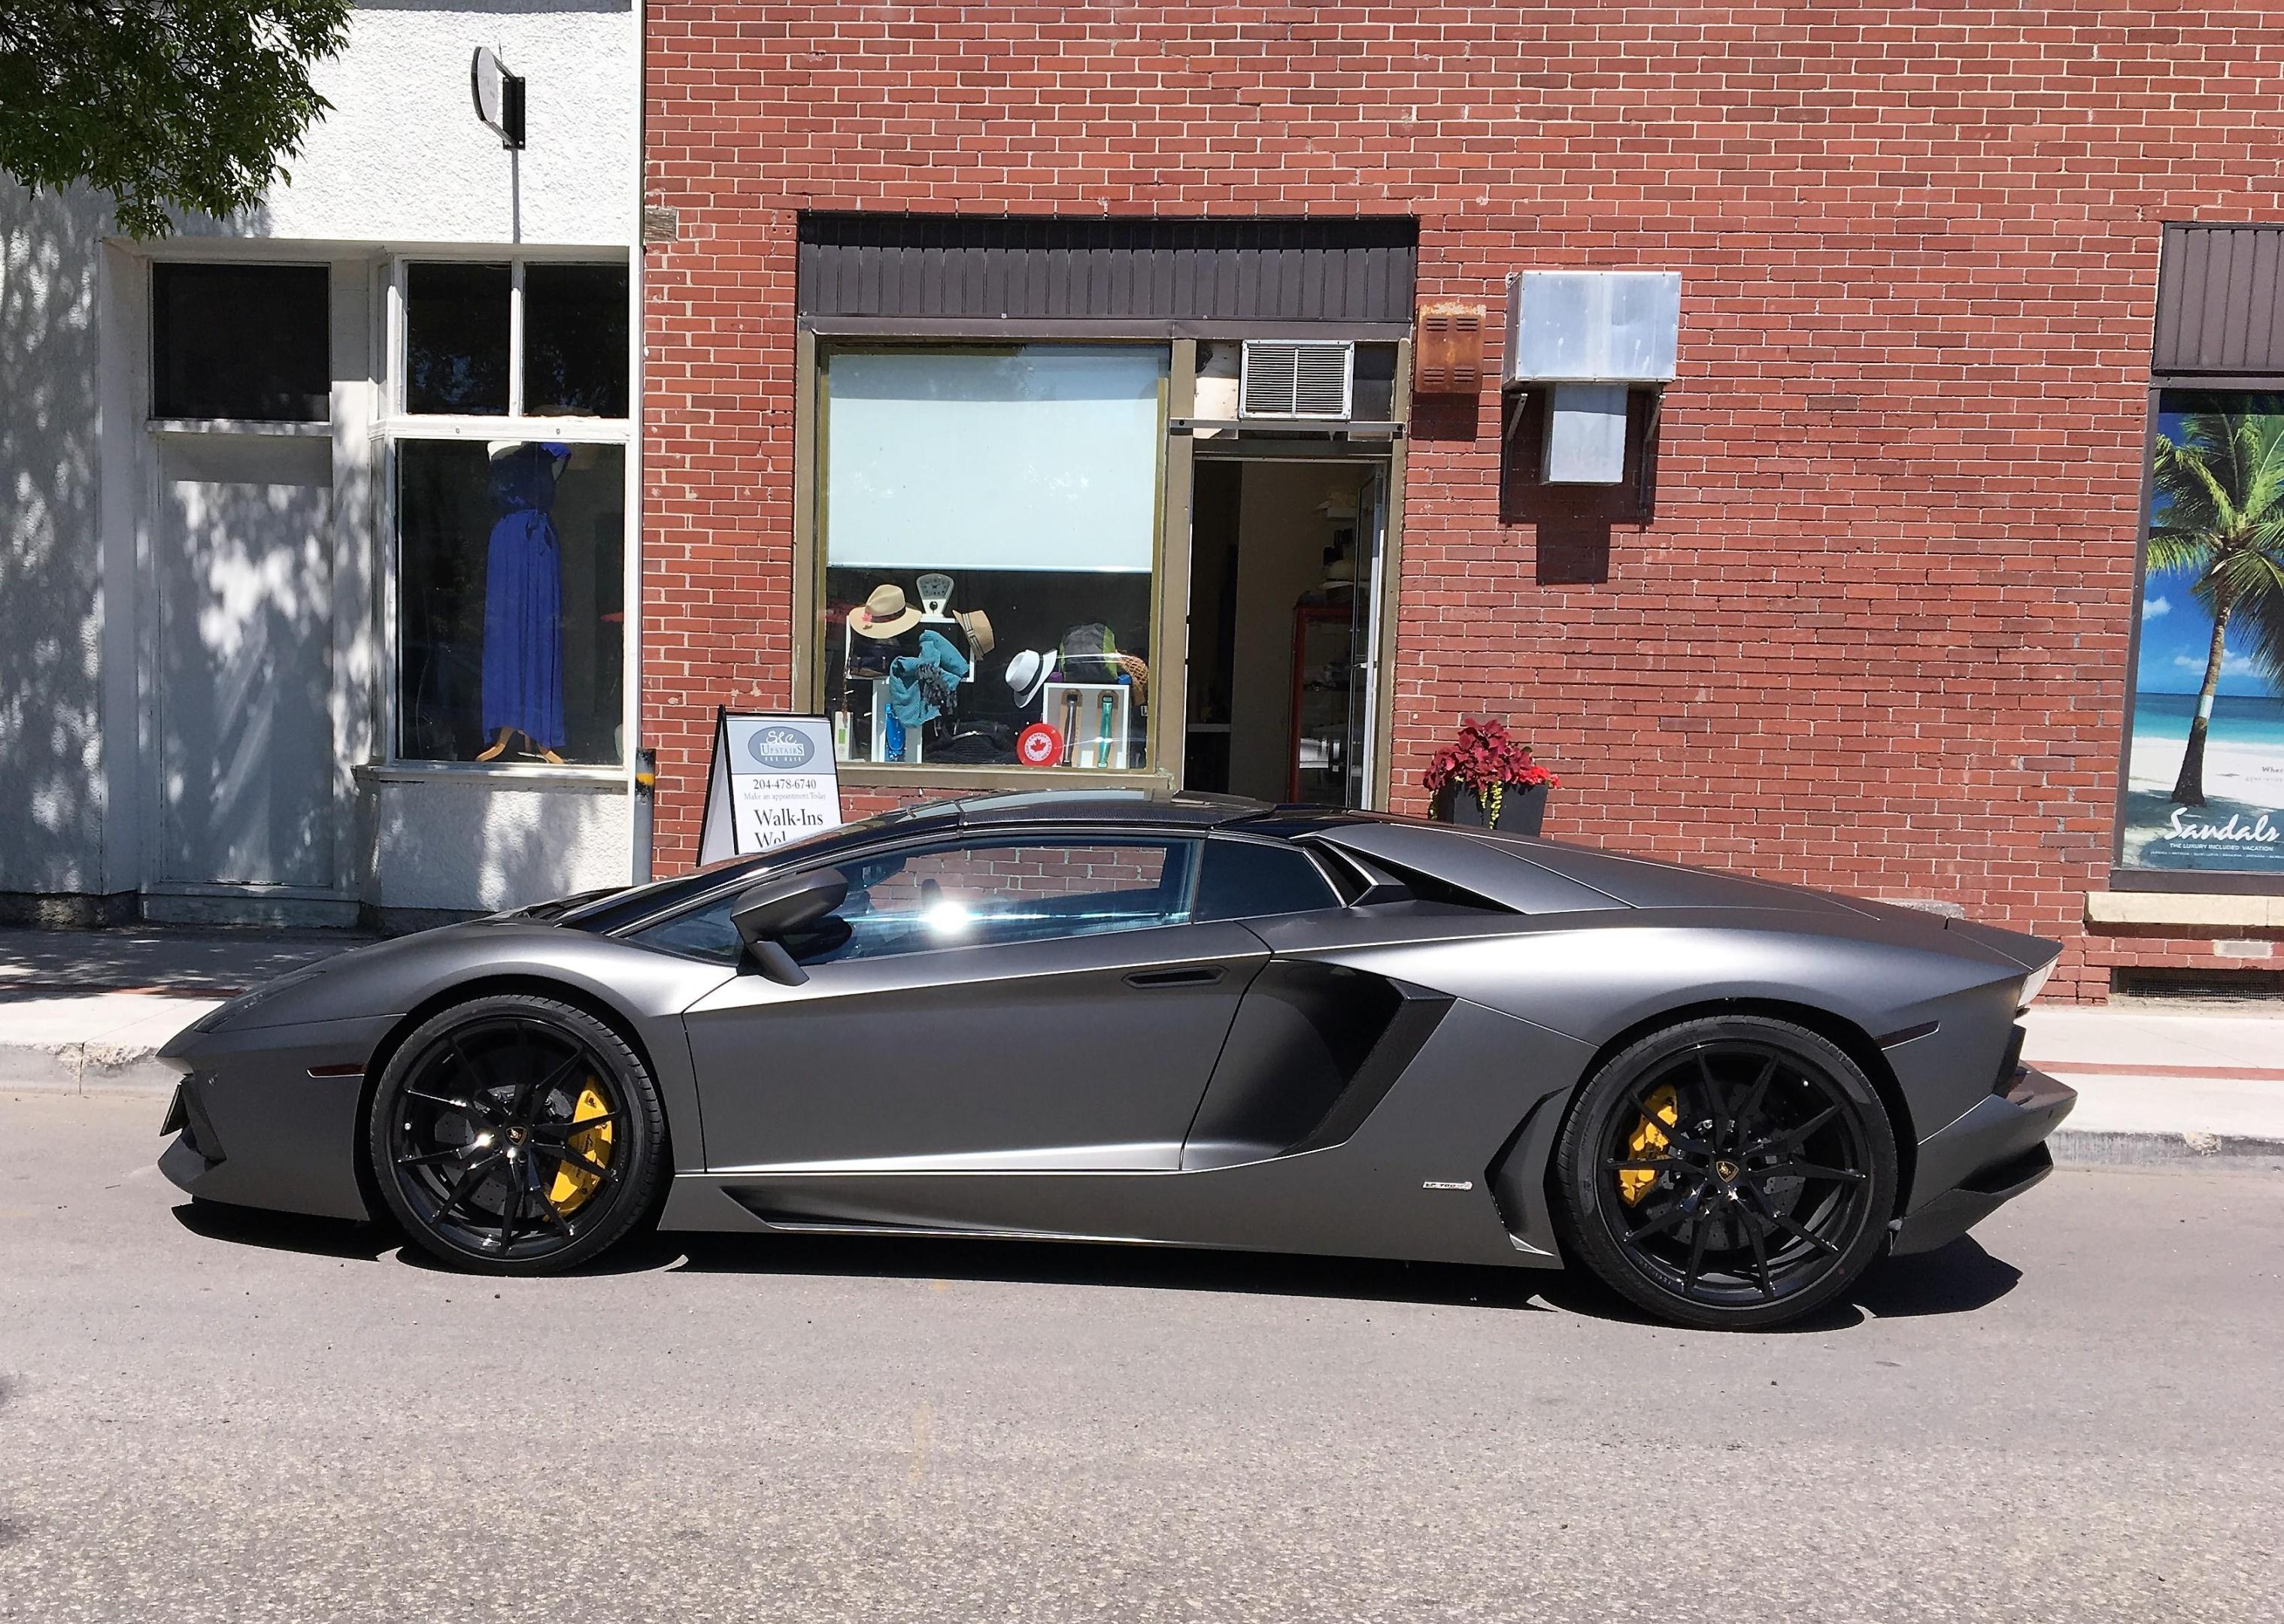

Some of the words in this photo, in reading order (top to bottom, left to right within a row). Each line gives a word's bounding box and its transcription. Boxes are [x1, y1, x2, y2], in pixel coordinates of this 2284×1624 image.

[754, 778, 817, 790] 204-478-6740
[772, 793, 809, 801] appointment
[810, 792, 827, 801] Today
[754, 808, 824, 826] Walk-Ins
[2164, 807, 2280, 842] Sandals
